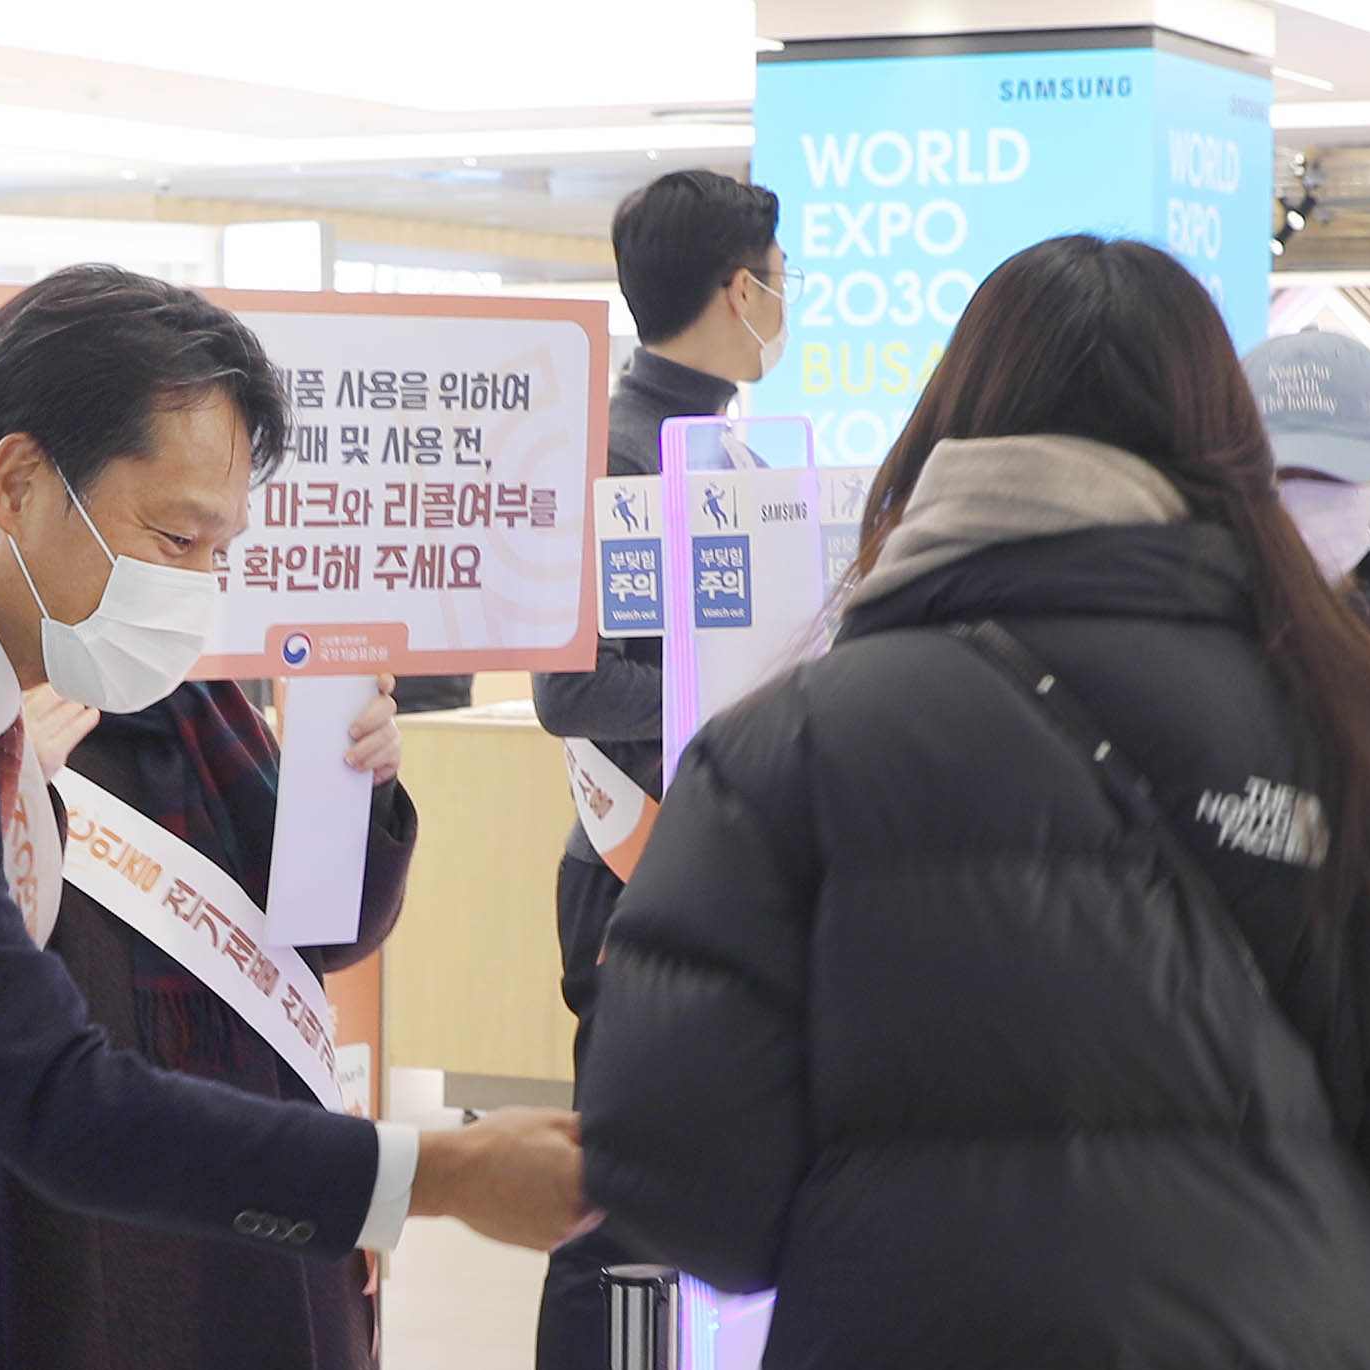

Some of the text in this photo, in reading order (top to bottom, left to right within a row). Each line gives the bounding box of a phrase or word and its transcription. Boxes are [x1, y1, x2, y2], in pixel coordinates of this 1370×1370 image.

[1000, 75, 1132, 102] SAMSUNG
[800, 128, 1031, 188] WORLD
[1167, 127, 1241, 194] WORLD
[800, 199, 968, 257] EXPO
[1167, 198, 1222, 261] EXPO
[336, 369, 429, 410] 사용을
[438, 371, 531, 412] 위하여
[341, 426, 369, 465] 및
[381, 427, 443, 466] 사용
[453, 428, 492, 470] 전,
[264, 482, 558, 529] 마크와 리콜여부를
[760, 501, 809, 523] SAMSUNG
[243, 544, 361, 592] 확인해
[374, 544, 482, 592] 주세요
[609, 573, 658, 603] 주의
[699, 570, 745, 601] 주의
